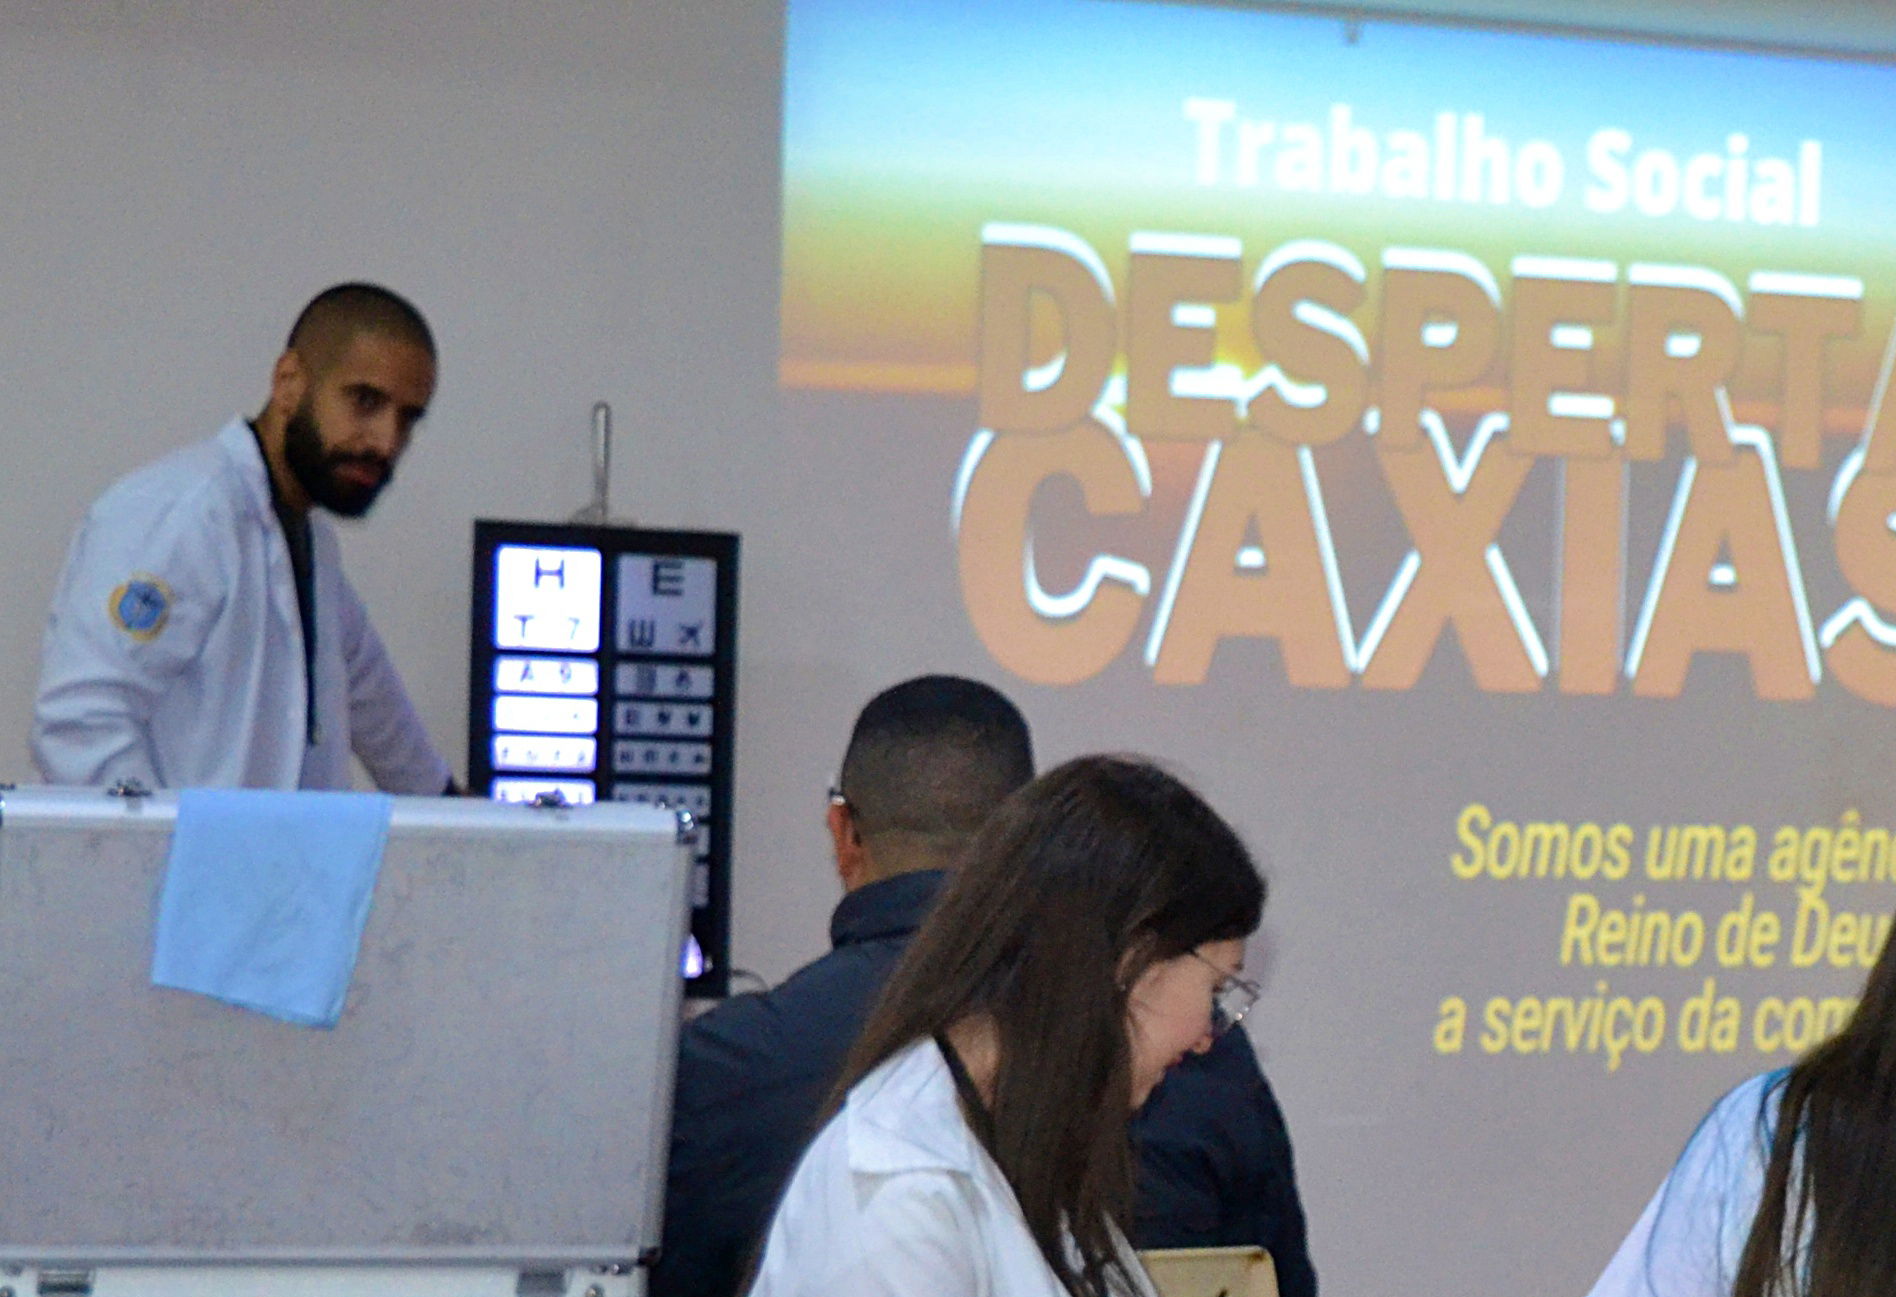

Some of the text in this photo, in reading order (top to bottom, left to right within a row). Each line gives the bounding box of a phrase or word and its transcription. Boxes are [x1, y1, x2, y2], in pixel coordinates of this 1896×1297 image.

[1186, 96, 1823, 228] Trabalho Social
[533, 557, 566, 589] H
[1450, 803, 1635, 880] Somos
[1645, 824, 1758, 881] uma
[1560, 891, 1894, 968] Reino de Deu
[1433, 996, 1467, 1054] a
[1479, 981, 1666, 1073] serviço
[1679, 978, 1742, 1053] da
